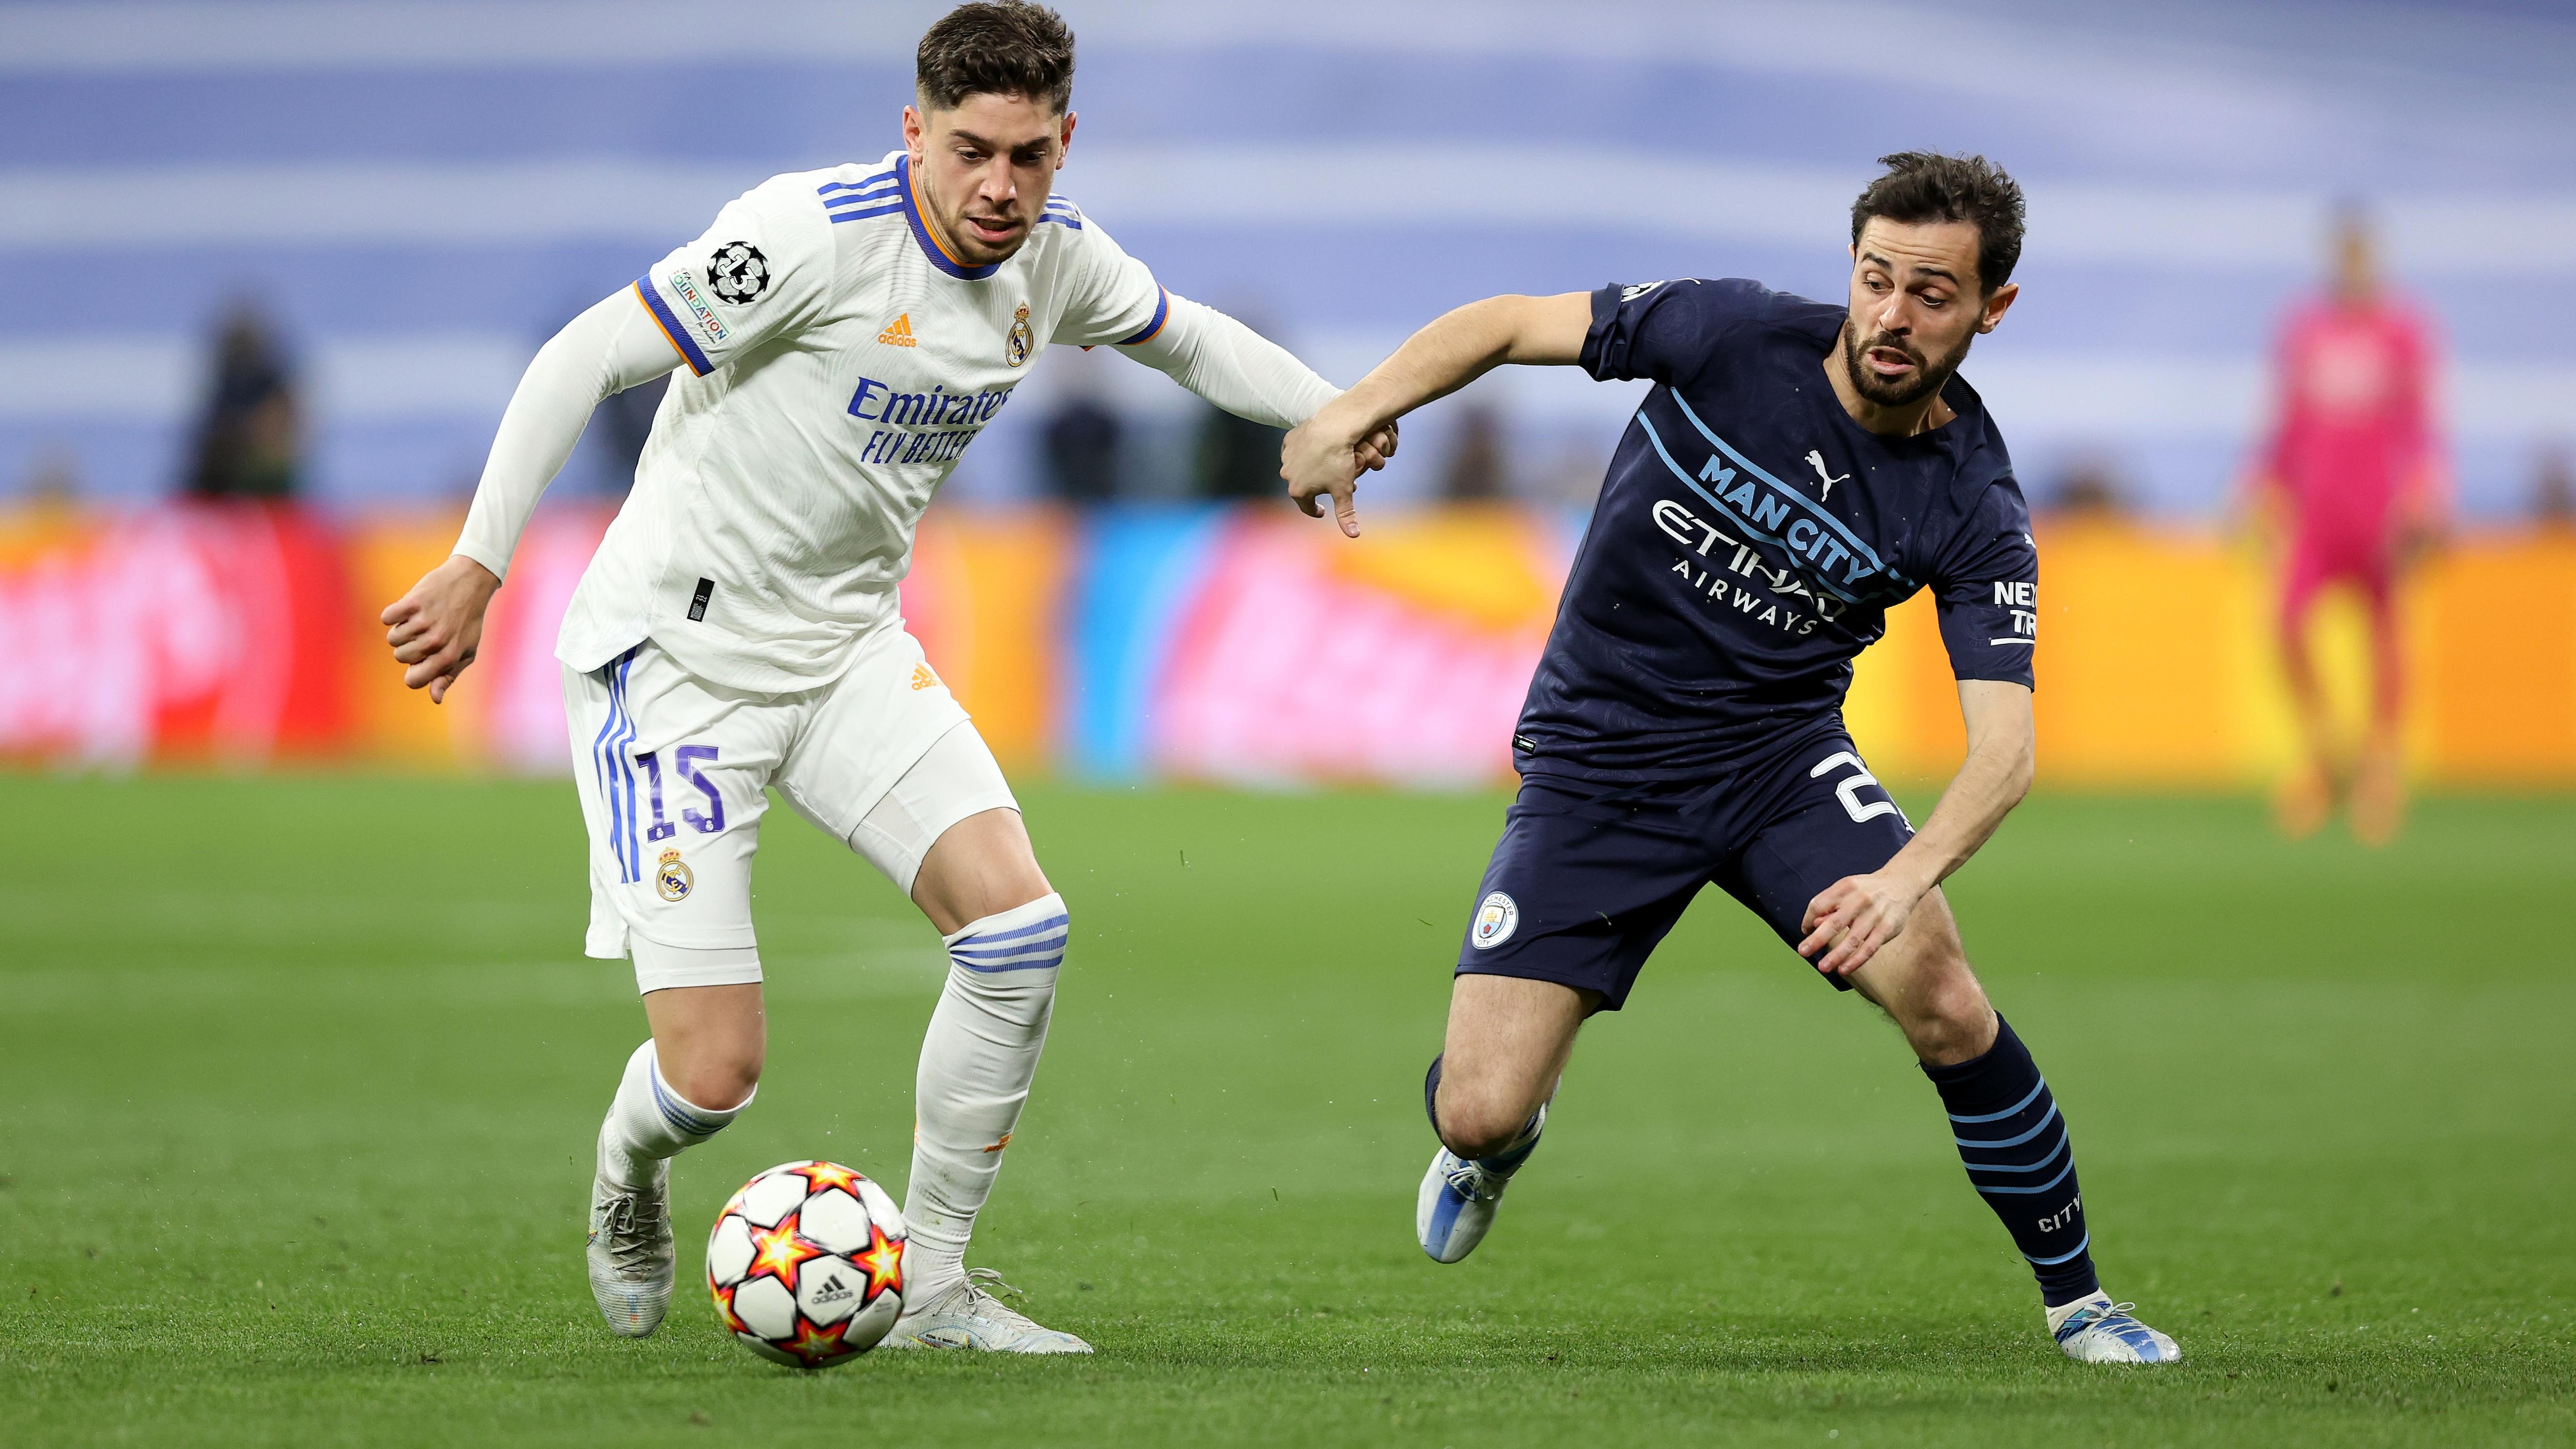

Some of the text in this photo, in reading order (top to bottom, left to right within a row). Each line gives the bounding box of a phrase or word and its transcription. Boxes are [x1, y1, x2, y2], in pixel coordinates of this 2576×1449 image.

[703, 329, 716, 345] children
[877, 333, 917, 348] adidas
[847, 377, 1014, 425] Emirates
[860, 430, 977, 464] FLY BETTER
[1698, 453, 1875, 586] MAN CITY
[1672, 559, 1818, 635] AIRWAYS
[1994, 582, 2038, 608] NEX
[634, 744, 725, 843] 15
[1810, 751, 1901, 823] 2
[2039, 1192, 2080, 1232] CITY
[811, 1290, 853, 1304] adidas
